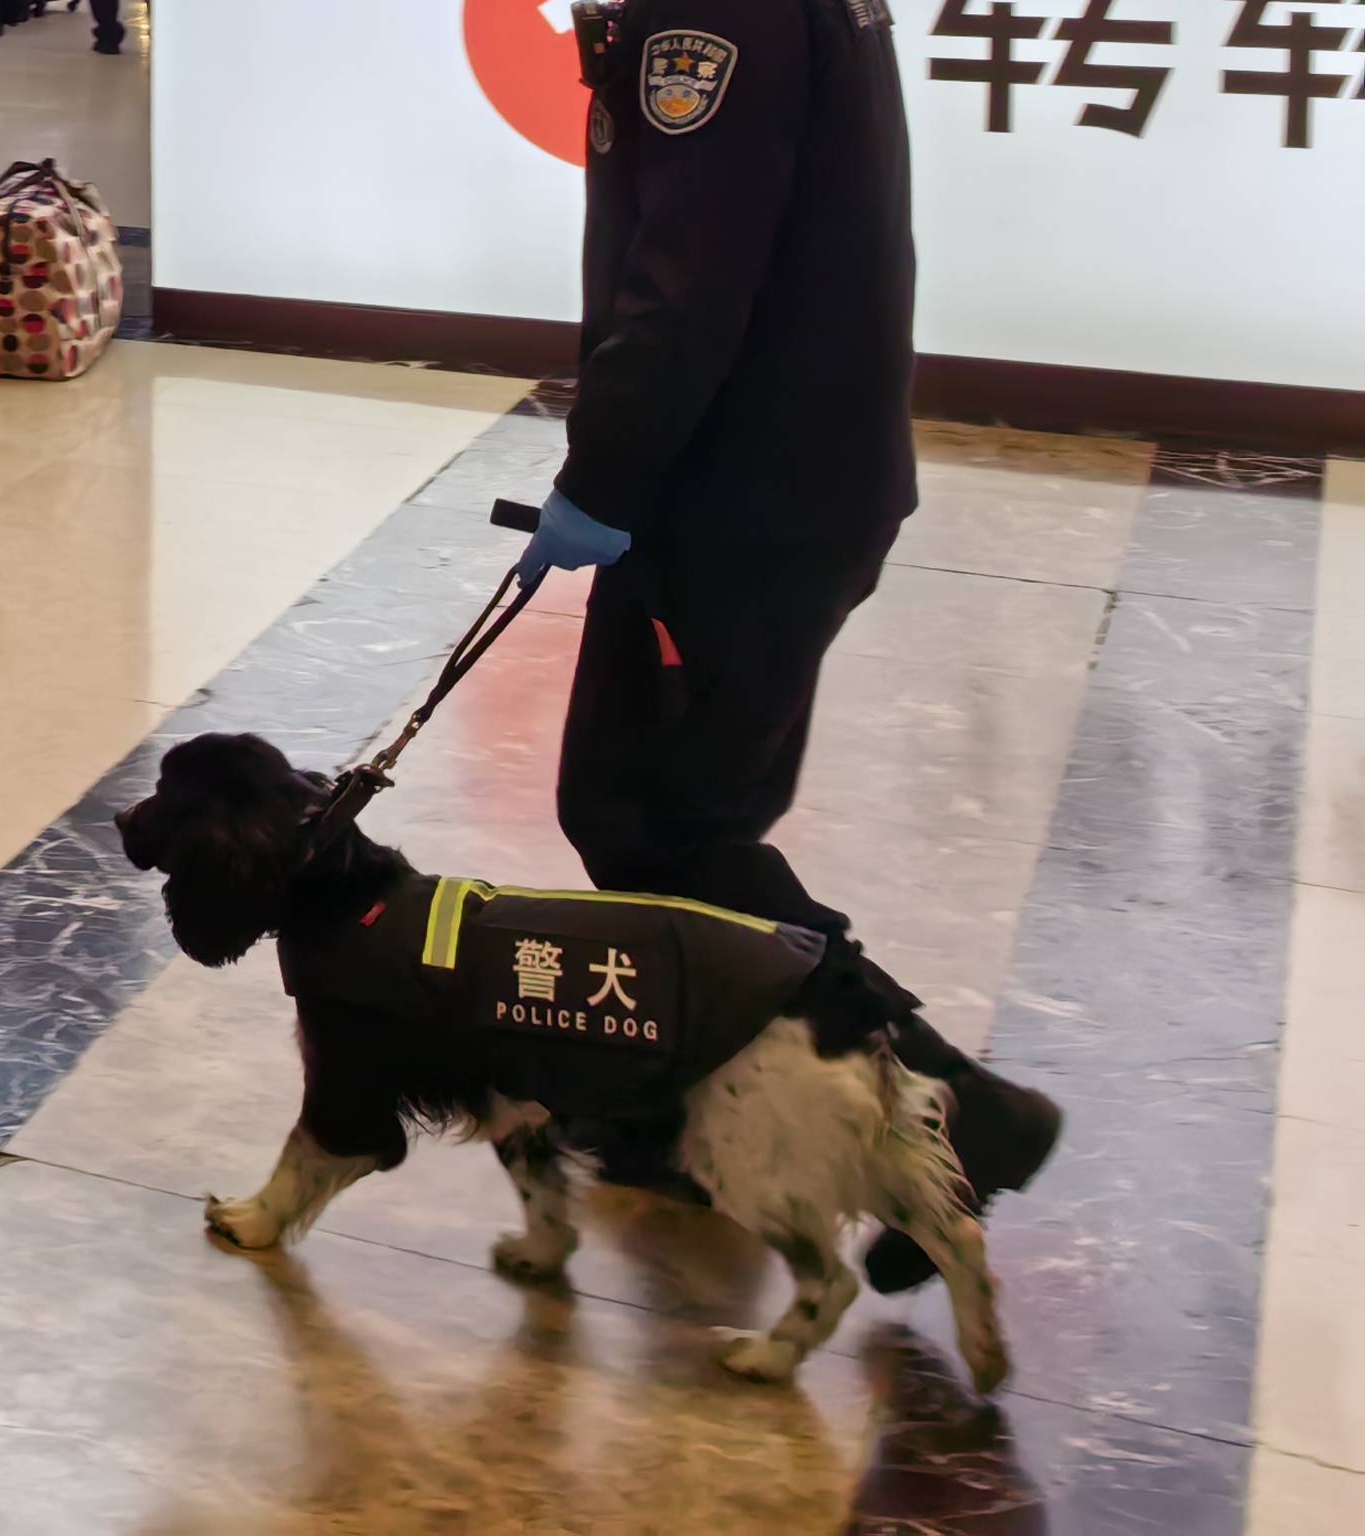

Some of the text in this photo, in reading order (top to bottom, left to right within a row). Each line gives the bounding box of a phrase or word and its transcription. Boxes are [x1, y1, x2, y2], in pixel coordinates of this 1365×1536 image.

[513, 938, 638, 1011] 警犬
[496, 1000, 659, 1041] POLICE DOG
